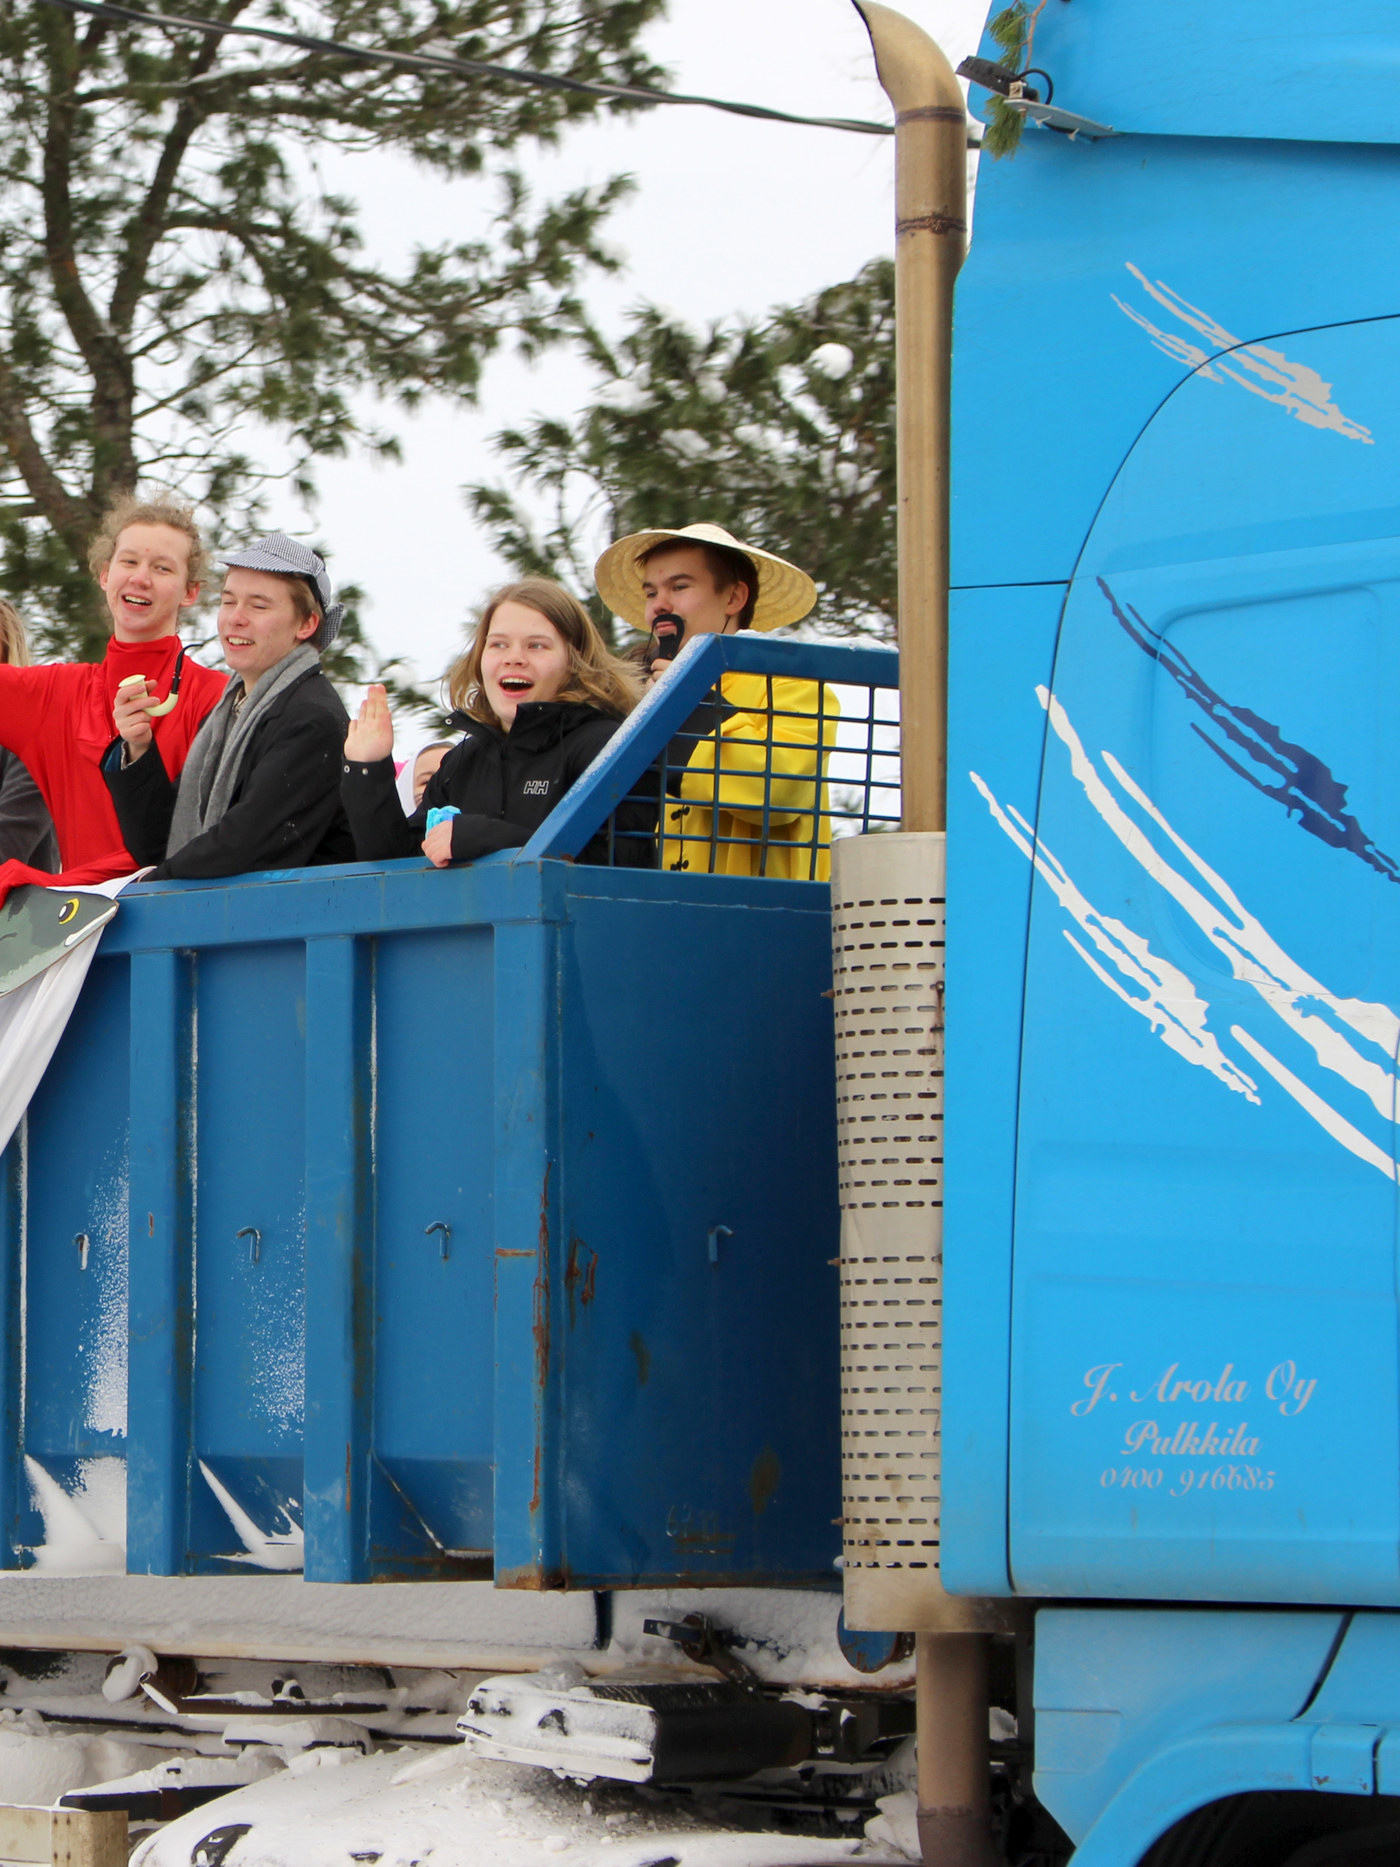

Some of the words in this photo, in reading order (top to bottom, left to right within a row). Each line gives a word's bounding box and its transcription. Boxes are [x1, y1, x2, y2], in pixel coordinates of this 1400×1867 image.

[523, 780, 550, 795] HH
[1070, 1362, 1123, 1416] J.
[1129, 1362, 1250, 1402] Arola
[1265, 1359, 1318, 1416] Oy
[1120, 1420, 1262, 1455] Pulkkila
[1100, 1465, 1164, 1488] 0400
[1169, 1463, 1277, 1497] 916685
